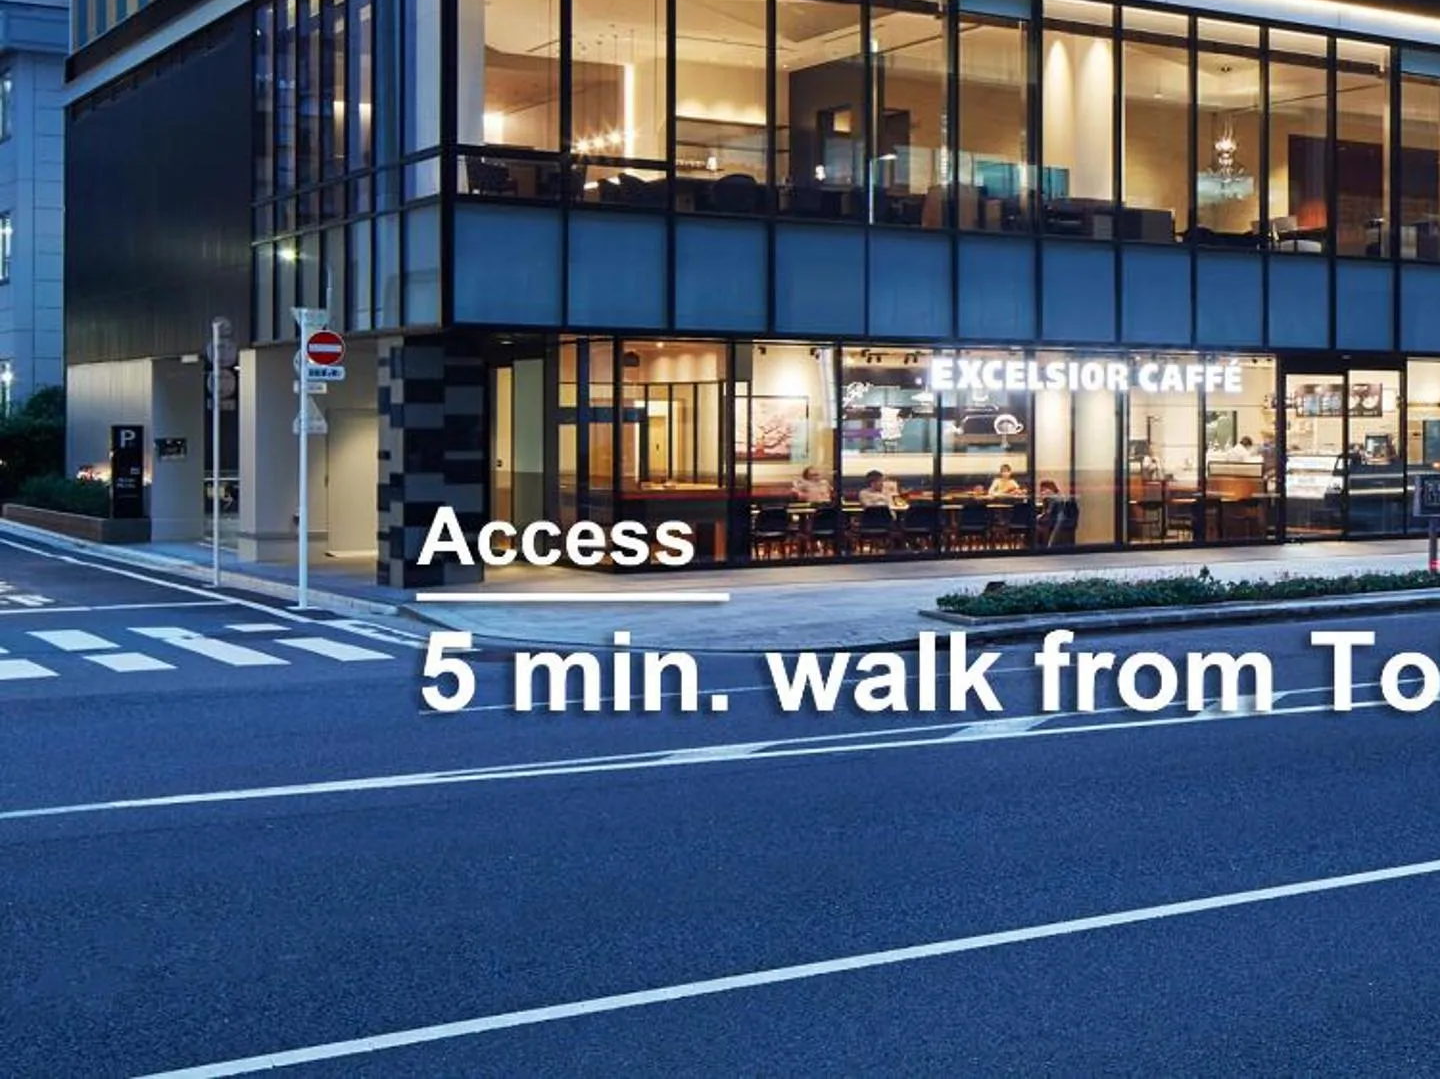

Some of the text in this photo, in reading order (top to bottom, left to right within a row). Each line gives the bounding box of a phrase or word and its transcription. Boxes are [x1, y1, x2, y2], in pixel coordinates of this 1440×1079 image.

[930, 356, 1244, 393] EXCELSIOR CAFFÉ
[119, 428, 137, 449] P
